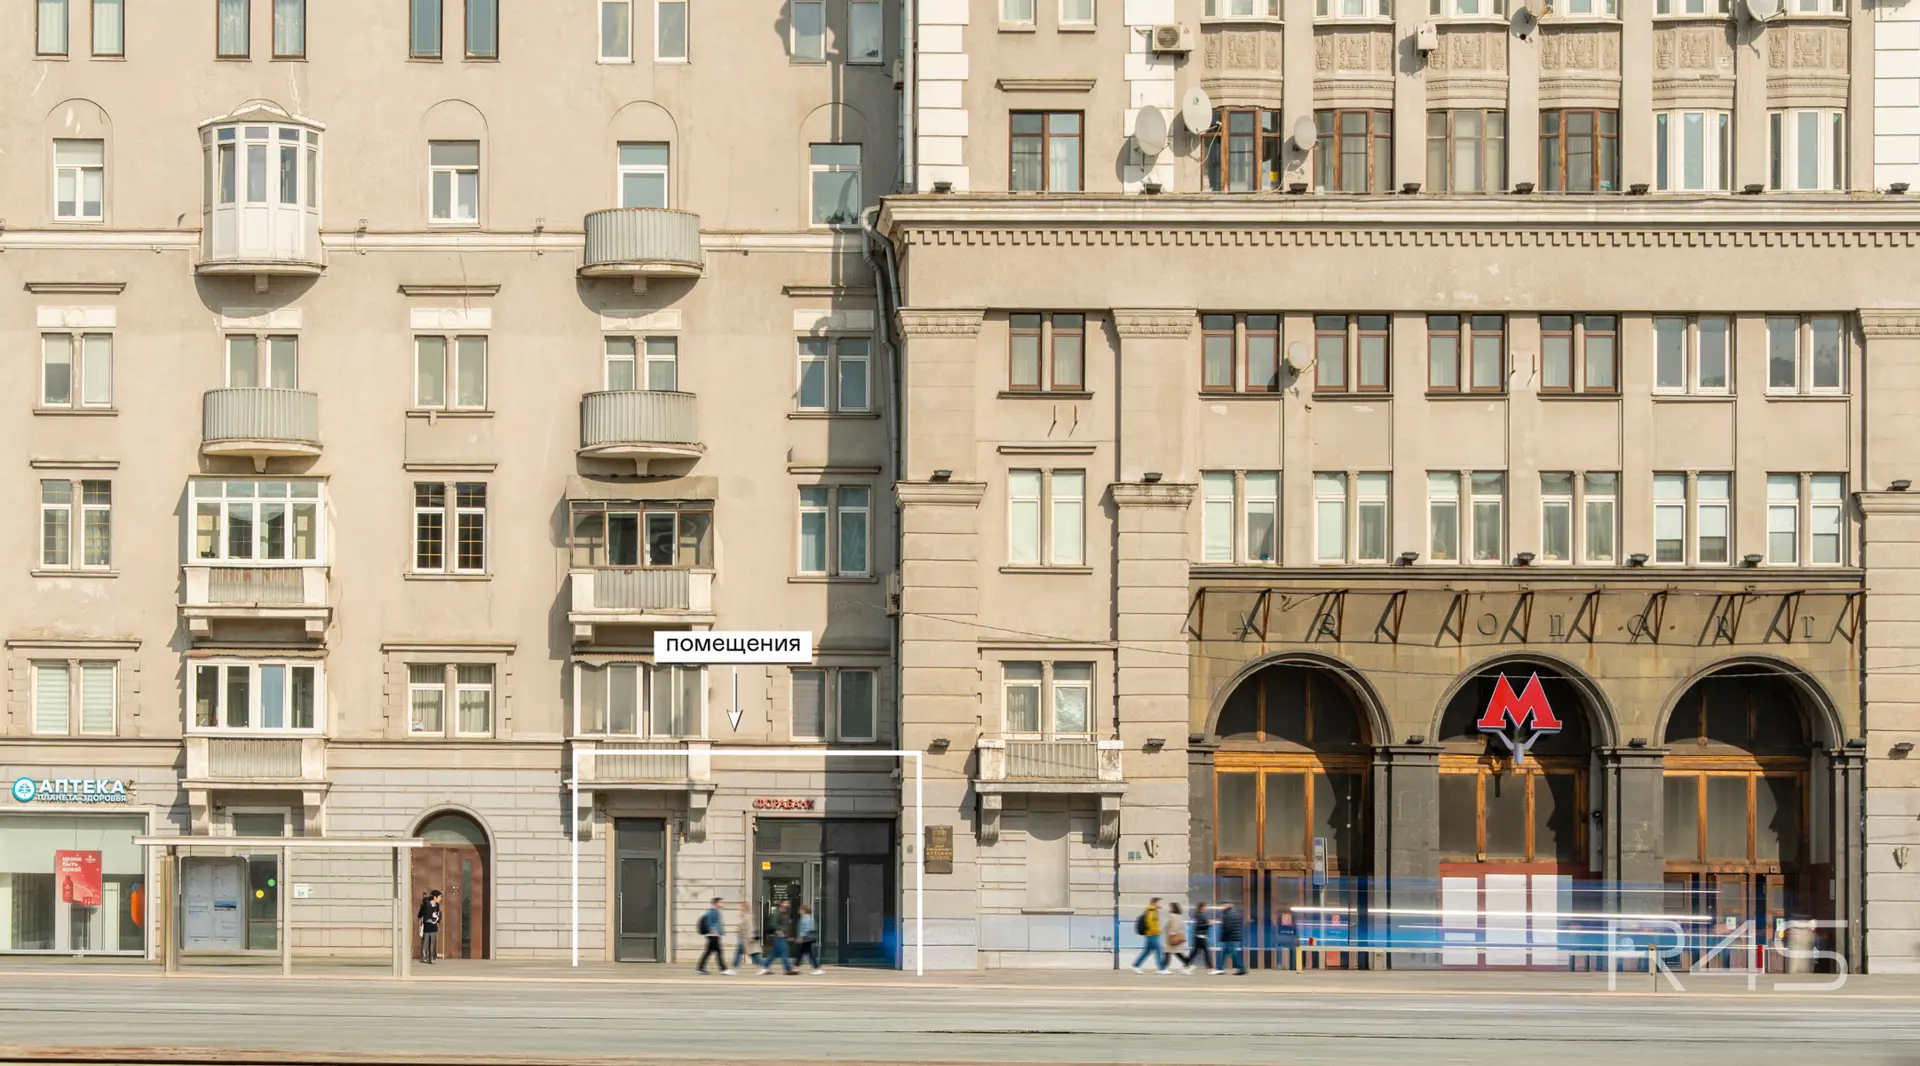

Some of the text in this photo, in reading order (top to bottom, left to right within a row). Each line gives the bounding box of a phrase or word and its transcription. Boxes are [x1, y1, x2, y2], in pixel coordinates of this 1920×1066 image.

[1231, 610, 1816, 640] АЭОПОРТ
[1477, 671, 1562, 729] М
[39, 779, 126, 794] АПТЕКА
[37, 794, 127, 804] ПЛАНЕТА ЗДОРОВЬЯ
